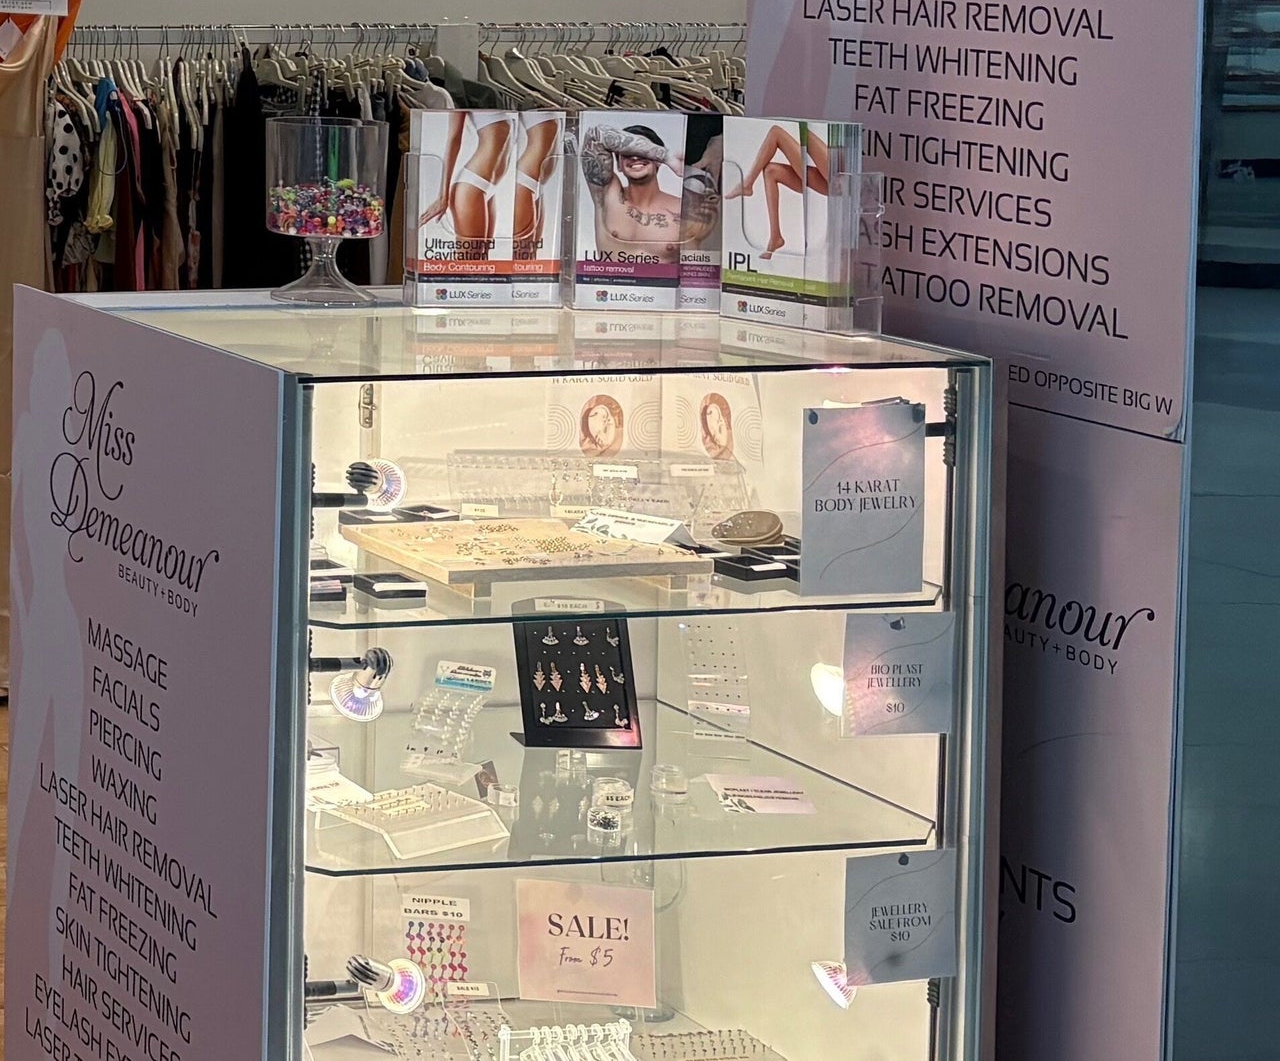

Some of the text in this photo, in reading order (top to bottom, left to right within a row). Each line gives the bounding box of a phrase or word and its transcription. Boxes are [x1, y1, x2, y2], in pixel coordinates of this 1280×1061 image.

[966, 4, 1114, 40] REMOVAL
[828, 37, 1079, 87] TEETH WHITENING
[854, 84, 1045, 131] FAT FREEZING
[899, 132, 1070, 183] TIGHTENING
[913, 179, 1052, 228] SERVICES
[424, 238, 496, 250] Ultrasound
[424, 249, 489, 261] Cavitation
[584, 250, 660, 265] LUX Series
[681, 253, 711, 263] acials
[922, 226, 1110, 286] EXTENSIONS
[423, 263, 496, 274] Body Contouring
[513, 263, 543, 273] touring
[583, 265, 635, 274] tattoo removal
[728, 251, 758, 274] IPL
[978, 283, 1129, 340] REMOVAL
[1034, 370, 1119, 404] OPPOSITE
[1123, 388, 1151, 411] BIG
[1155, 395, 1173, 415] W
[62, 370, 136, 500] Miss
[814, 494, 917, 514] BODY JEWELRY
[836, 478, 901, 495] 14 KARAT
[49, 452, 220, 594] Demeanour
[1004, 582, 1155, 650] anour
[87, 617, 168, 690] MASSAGE
[871, 663, 924, 675] BIO PLAST
[93, 666, 161, 732] FACIALS
[867, 677, 921, 689] JEWELLERY
[886, 702, 905, 713] $10
[89, 708, 162, 782] PIERCING
[91, 754, 158, 826] WAXING
[40, 762, 218, 919] LASER HAIR REMOVAL
[54, 815, 197, 951] TEETH WHITENING
[403, 908, 464, 918] BARS $10
[411, 897, 458, 906] NIPPLE
[871, 902, 928, 920] JEWELLERY
[68, 872, 178, 984] FAT FREEZING
[547, 912, 630, 941] SALE!
[869, 915, 931, 931] SALE FROM
[890, 930, 911, 942] $10
[559, 946, 583, 966] From
[55, 906, 191, 1044] SKIN TIGHTENING
[62, 953, 98, 1011] HAIR
[35, 973, 102, 1059] EYELASH
